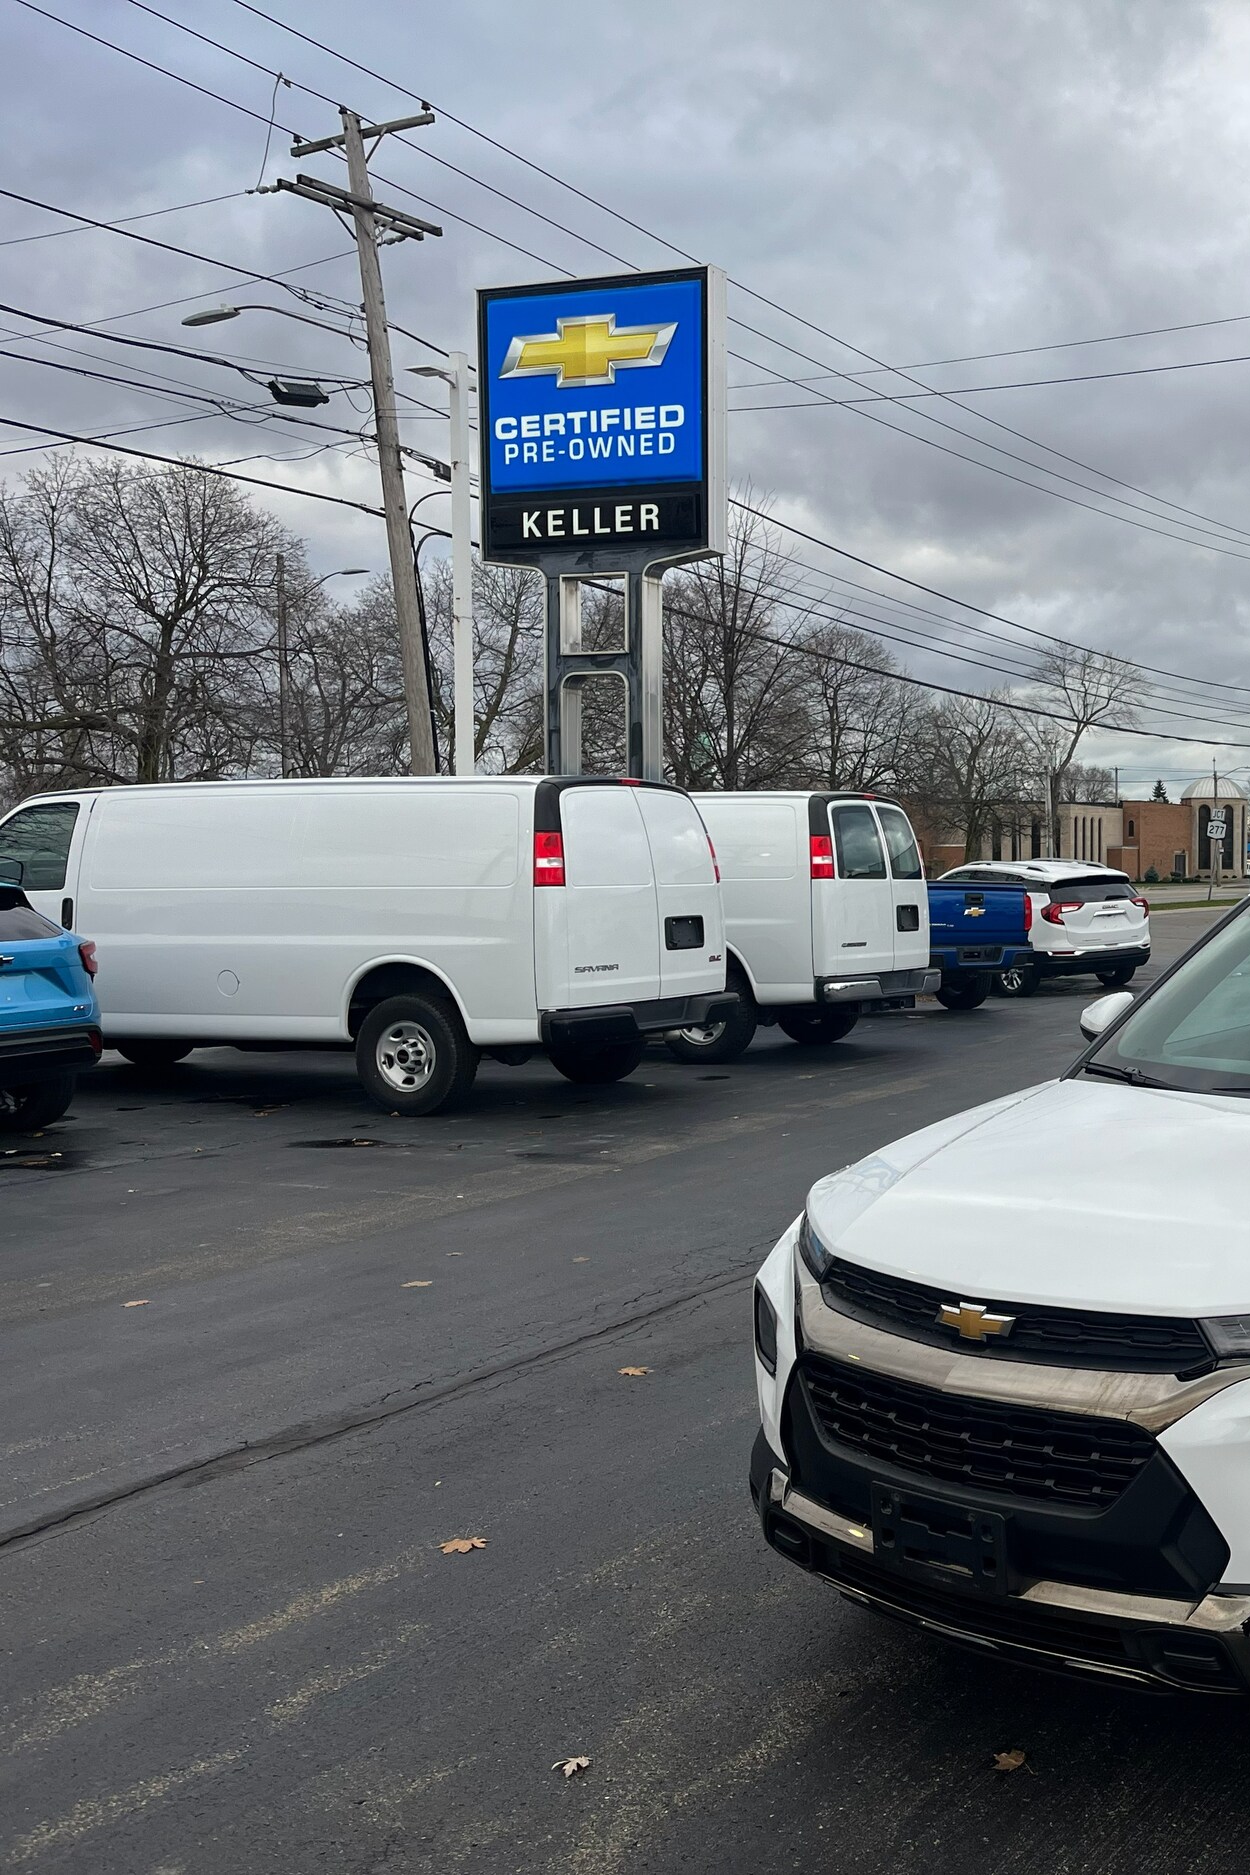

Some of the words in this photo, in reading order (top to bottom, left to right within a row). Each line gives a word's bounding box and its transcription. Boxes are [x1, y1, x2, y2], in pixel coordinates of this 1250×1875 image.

[495, 404, 685, 439] CERTIFIED
[504, 432, 675, 465] PRE-OWNED
[522, 503, 660, 538] KELLER
[1212, 810, 1225, 819] JCT
[1208, 824, 1225, 835] 277
[574, 963, 619, 974] SAVANA
